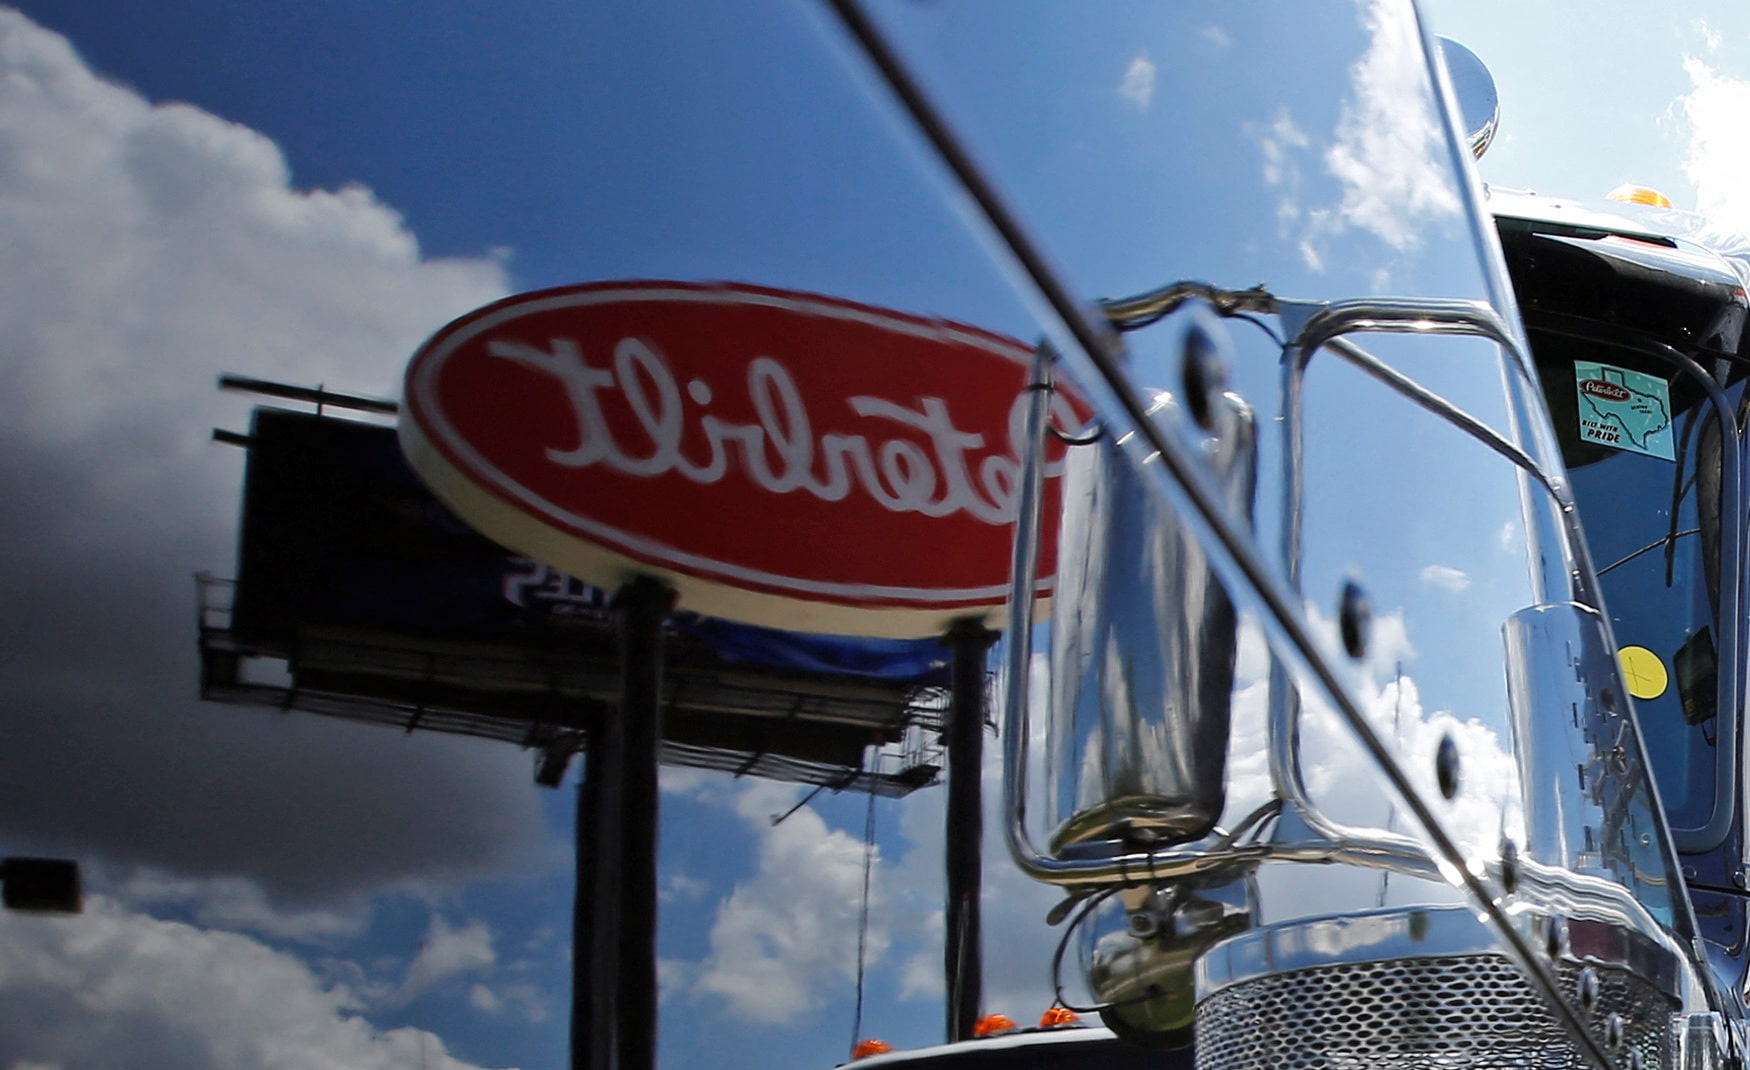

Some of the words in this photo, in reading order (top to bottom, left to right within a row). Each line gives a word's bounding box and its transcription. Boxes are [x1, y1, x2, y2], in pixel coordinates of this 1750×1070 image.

[1586, 381, 1627, 399] Peterbilt
[1600, 423, 1618, 433] WITH
[1587, 429, 1621, 443] PRIDE
